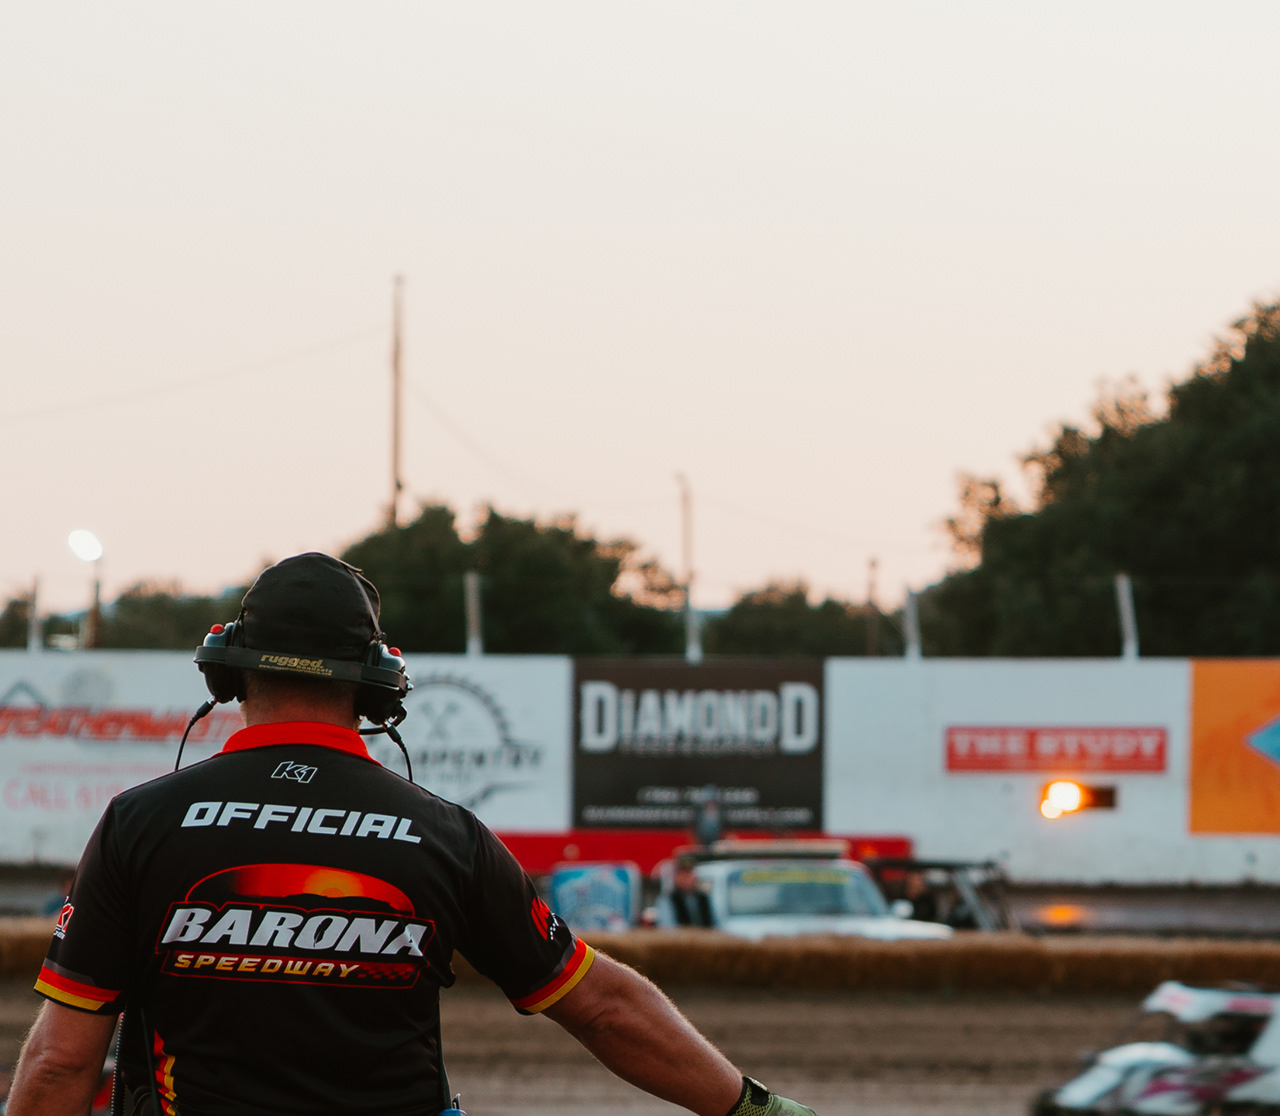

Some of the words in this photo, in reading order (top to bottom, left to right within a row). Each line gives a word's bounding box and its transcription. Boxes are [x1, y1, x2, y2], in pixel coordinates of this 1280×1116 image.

[950, 733, 1027, 760] THE
[1036, 733, 1162, 760] STUDY
[271, 761, 318, 784] K1
[180, 801, 422, 844] OFFICIAL
[162, 908, 424, 957] BARONA
[174, 952, 361, 979] SPEEDWAY
